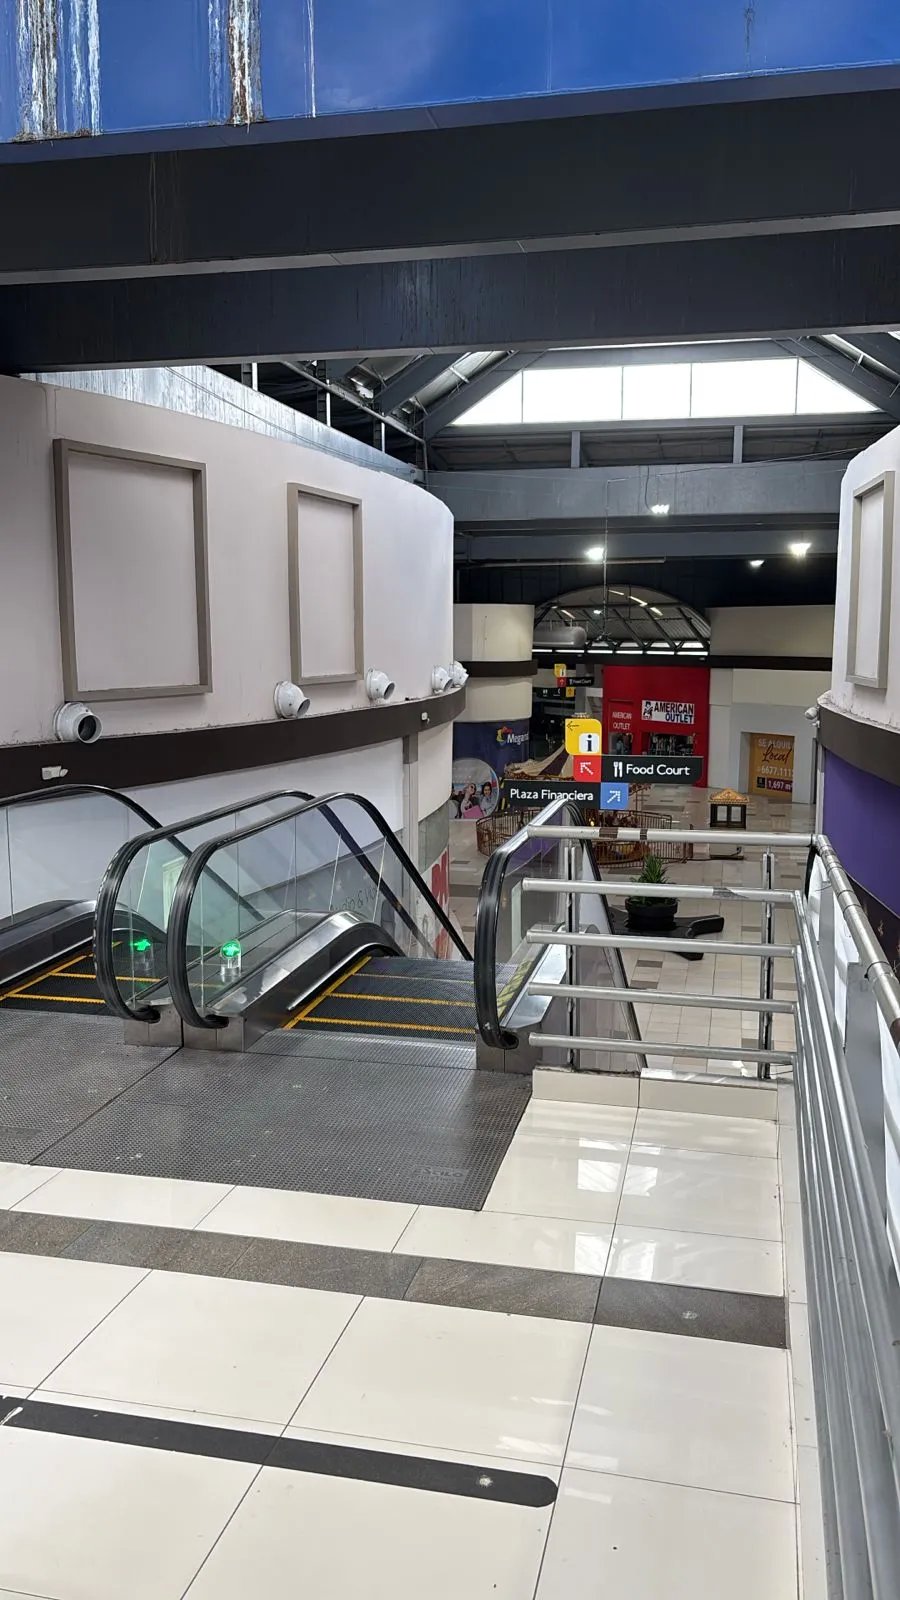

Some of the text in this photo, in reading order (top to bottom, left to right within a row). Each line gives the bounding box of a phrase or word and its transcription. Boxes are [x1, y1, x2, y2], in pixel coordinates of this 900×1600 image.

[653, 702, 694, 714] AMERICAN
[612, 711, 632, 719] AMERICAN
[665, 713, 693, 723] OUTLET
[613, 722, 630, 730] OUTLET
[762, 743, 792, 764] Local
[626, 764, 691, 776] Food Court
[510, 788, 594, 801] Plaza Financiera
